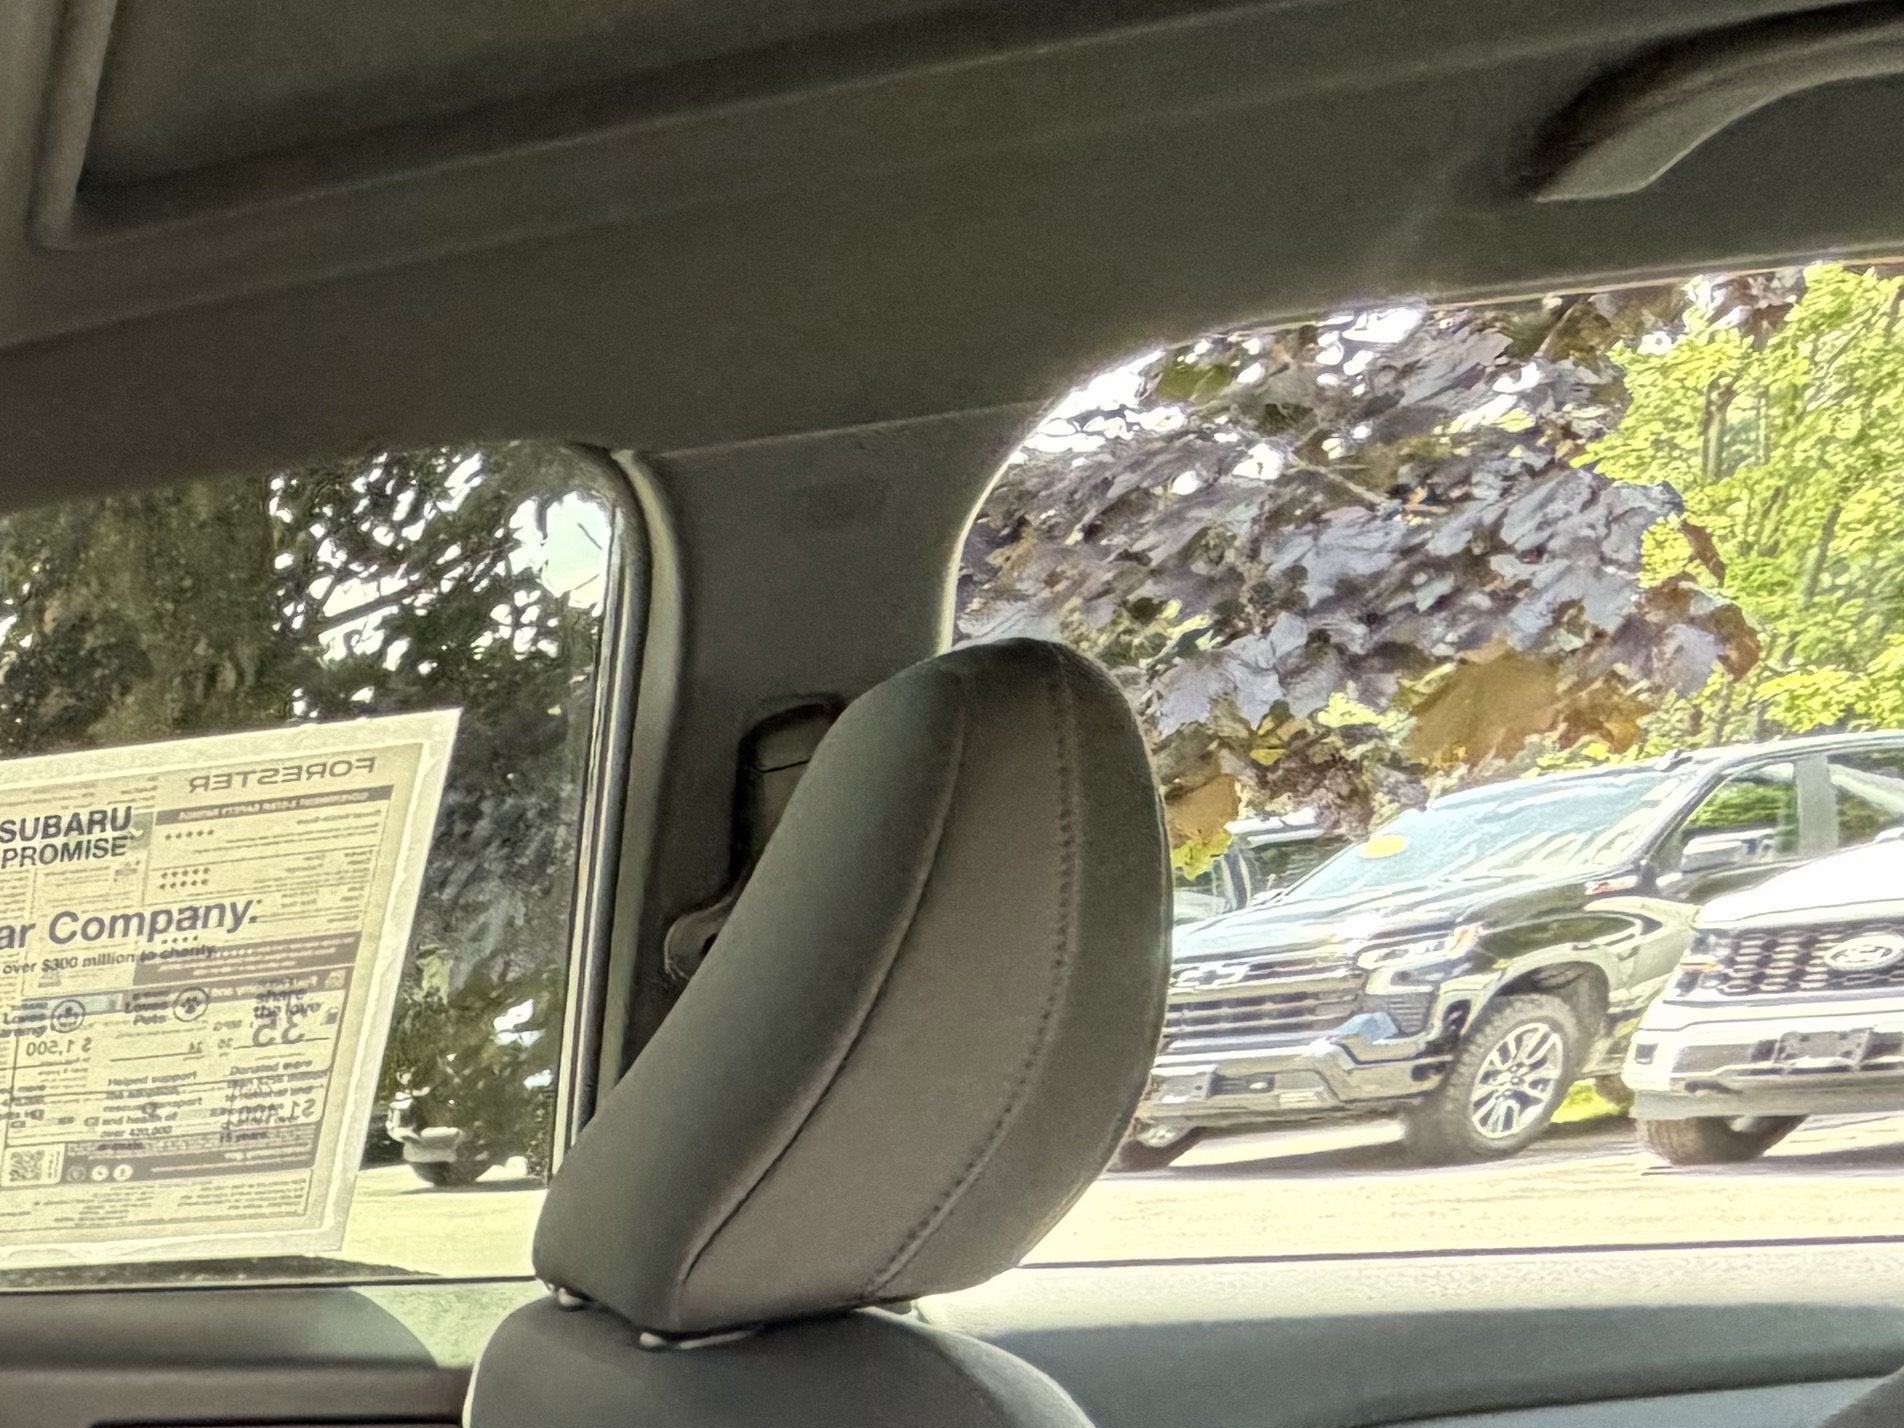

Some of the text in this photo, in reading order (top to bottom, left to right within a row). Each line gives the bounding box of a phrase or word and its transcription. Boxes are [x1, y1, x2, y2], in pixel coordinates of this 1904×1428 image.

[0, 836, 129, 869] PROMISE
[48, 900, 259, 944] Company.
[2, 961, 37, 975] over
[82, 952, 135, 969] million
